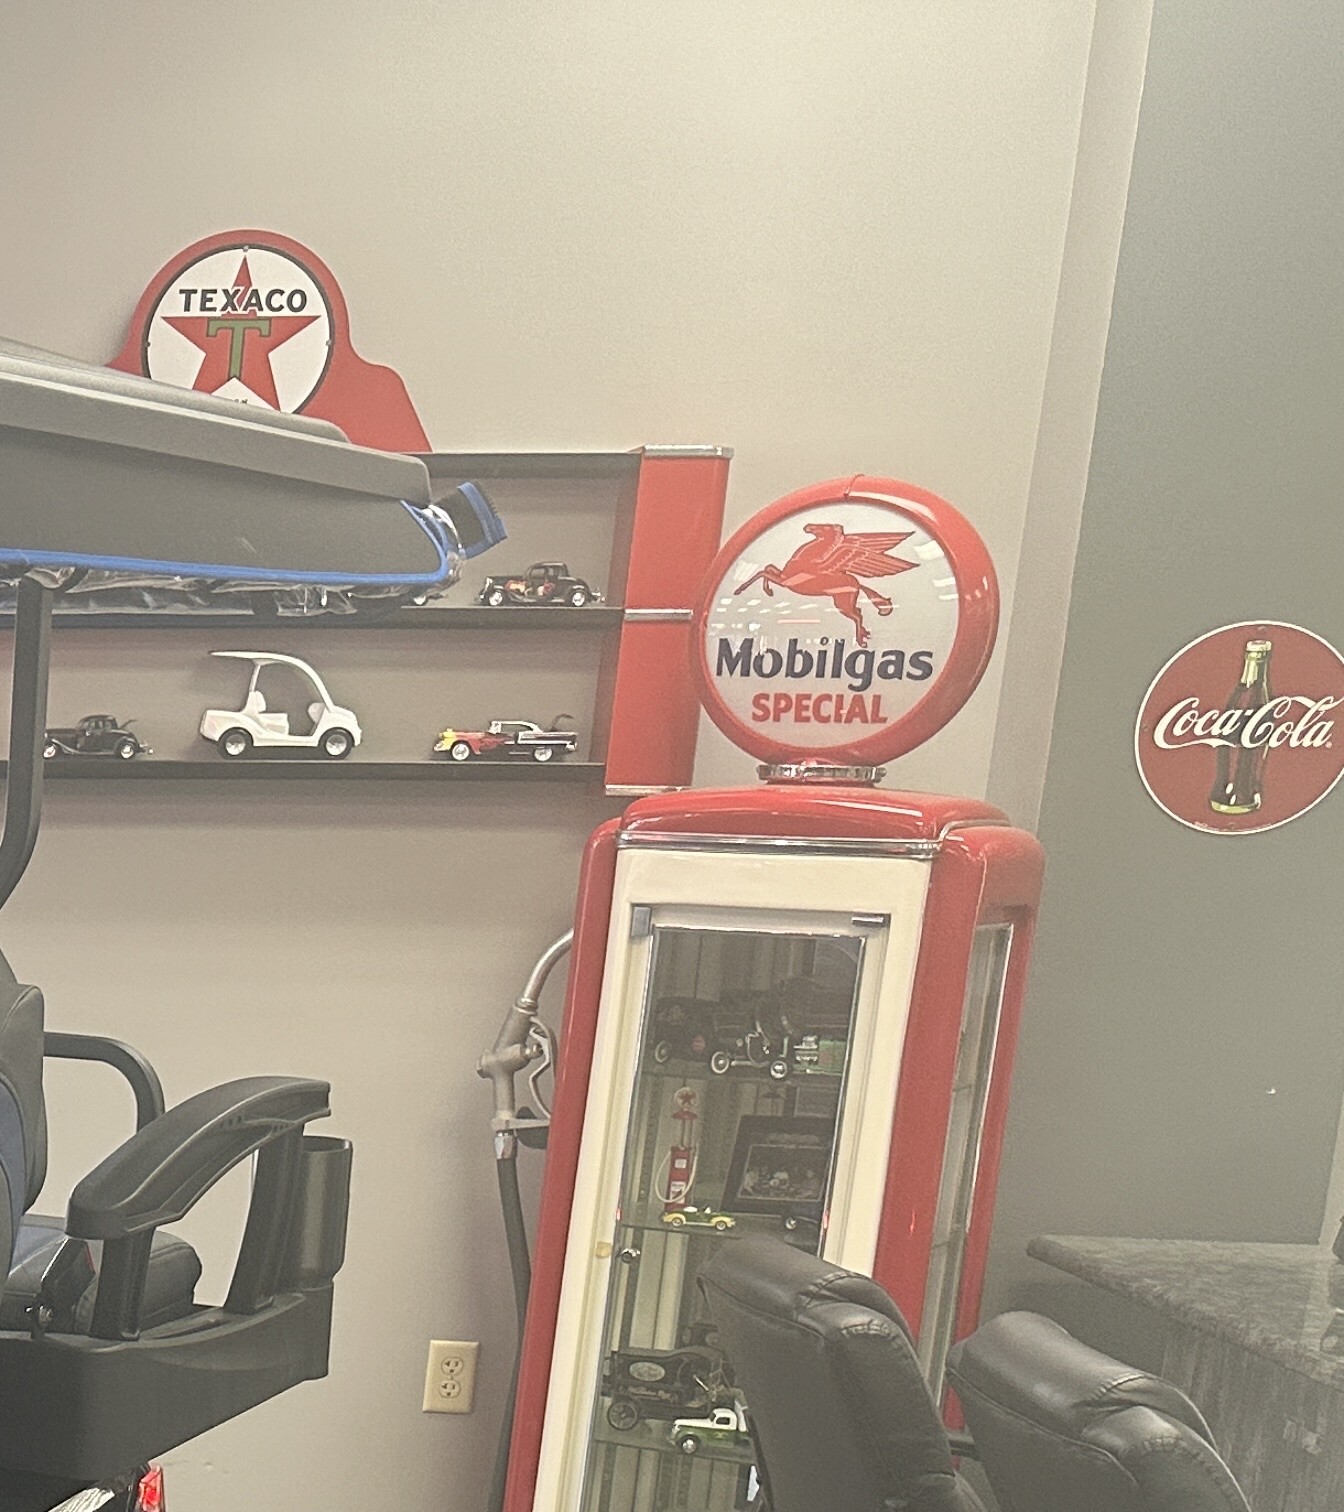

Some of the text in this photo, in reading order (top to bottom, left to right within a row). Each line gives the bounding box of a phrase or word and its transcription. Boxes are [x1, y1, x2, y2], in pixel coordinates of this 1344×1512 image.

[179, 288, 308, 313] TEXACO
[205, 316, 273, 381] T
[716, 636, 934, 692] Mobilgas
[752, 692, 889, 724] SPECIAL
[1154, 696, 1342, 749] Coca-Cola
